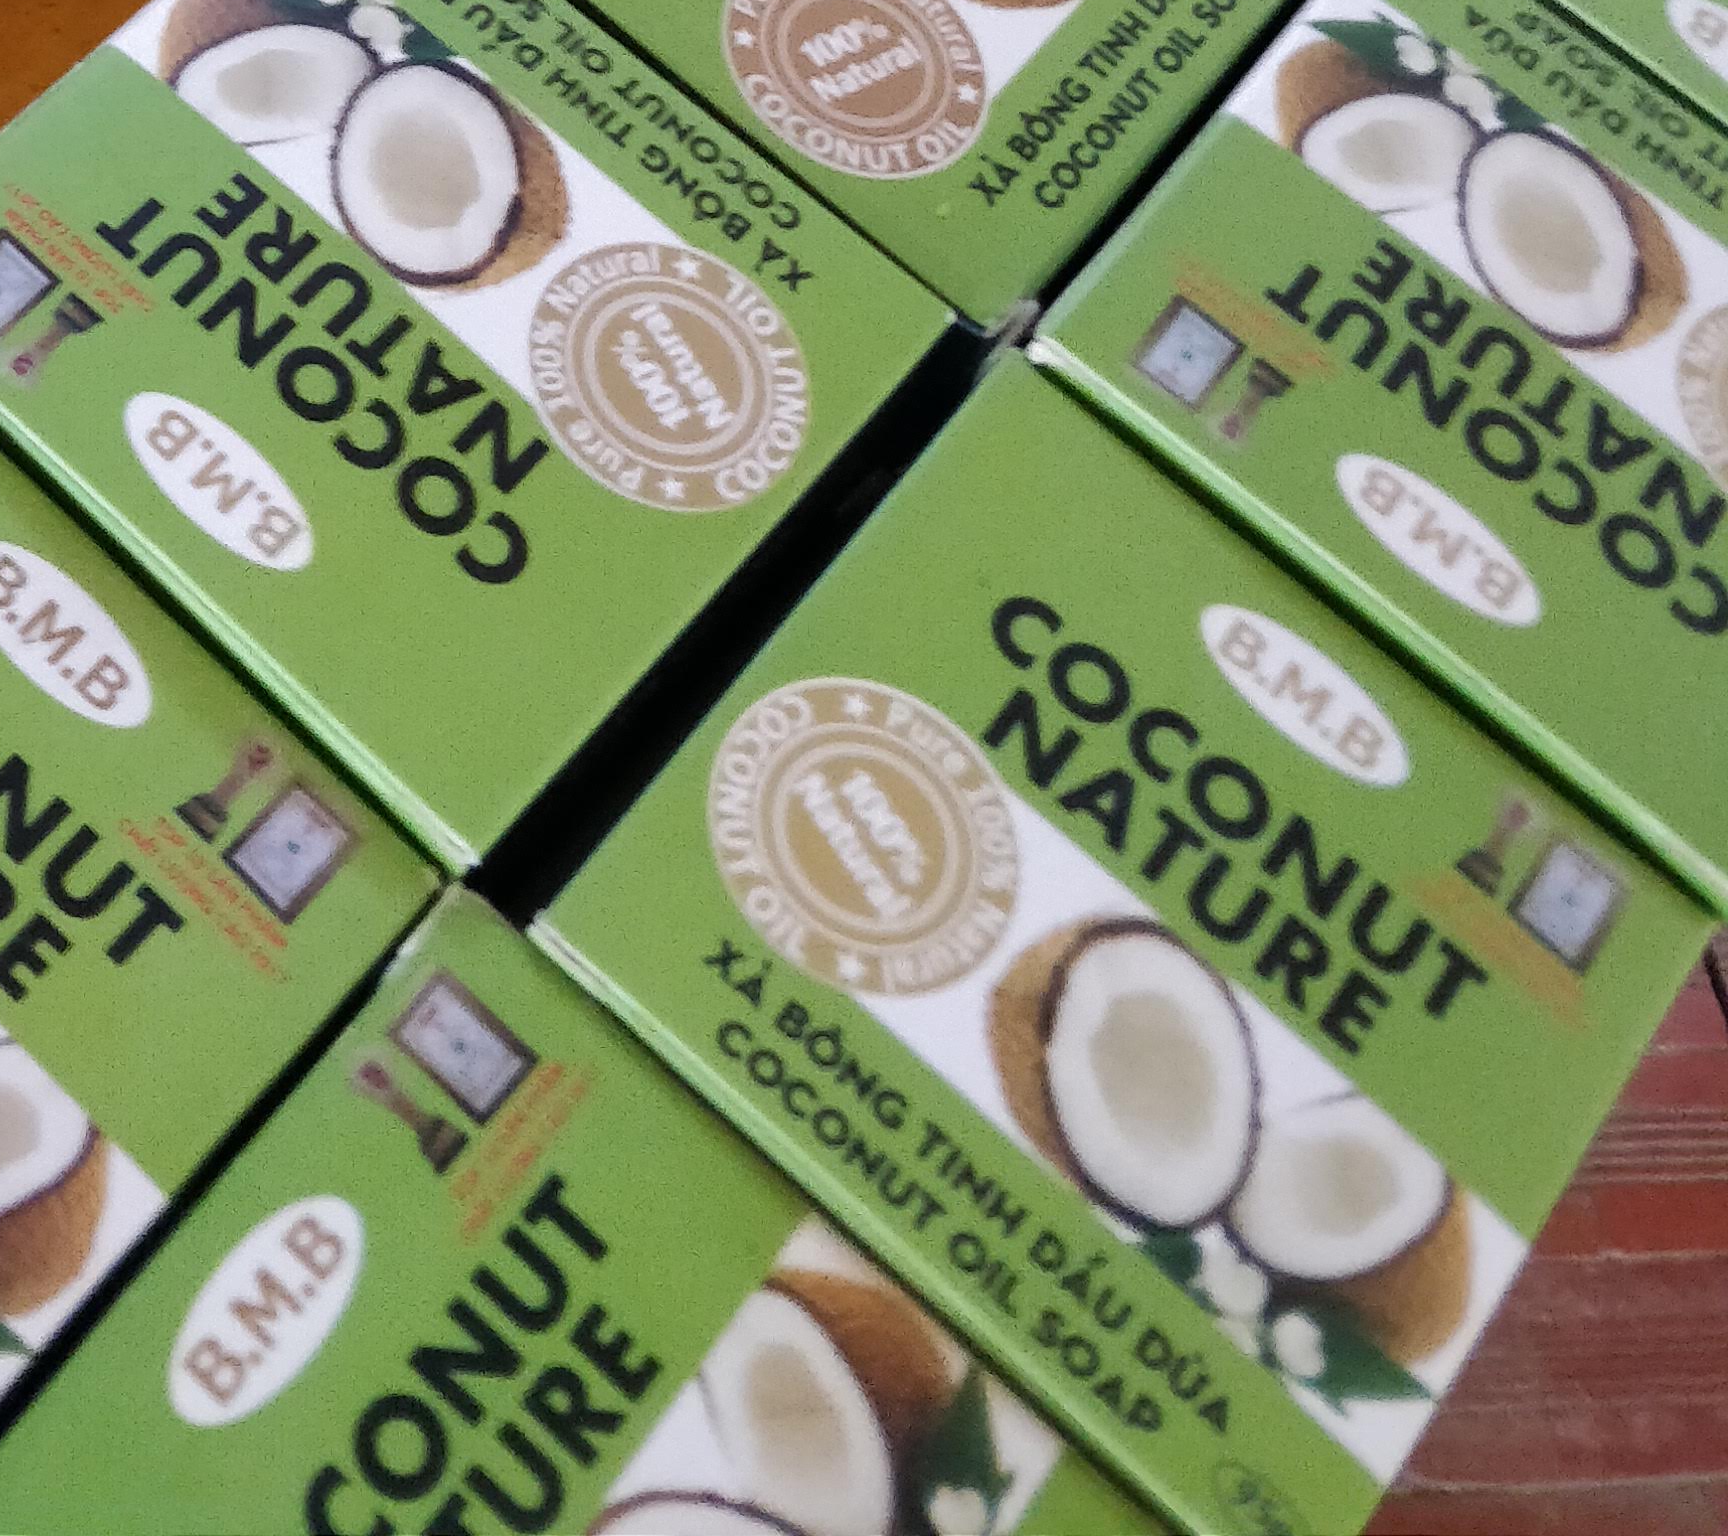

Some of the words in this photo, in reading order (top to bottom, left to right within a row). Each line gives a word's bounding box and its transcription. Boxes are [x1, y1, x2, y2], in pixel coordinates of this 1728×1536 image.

[543, 65, 637, 149] TINH
[555, 23, 613, 76] OIL
[1034, 67, 1163, 209] COCONUT
[1152, 27, 1209, 74] OIL
[1075, 9, 1150, 79] TINH
[614, 79, 803, 230] COCONUT
[194, 170, 550, 495] NATURE
[724, 273, 780, 338] OIL
[94, 196, 531, 585] COCONUT
[713, 345, 808, 501] COCONUT
[1263, 263, 1728, 635] COCONUT
[1350, 238, 1726, 548] NATURE
[144, 409, 300, 557] B.M.B
[1218, 618, 1385, 770] B.M.B
[983, 688, 1391, 1056] NATURE
[990, 595, 1489, 1019] COCONUT
[717, 1021, 948, 1231] COCONUT
[946, 1231, 1019, 1318] OIL
[1032, 1307, 1165, 1433] SOAP
[917, 1123, 1031, 1239] TINH
[182, 1214, 345, 1406] B.M.B
